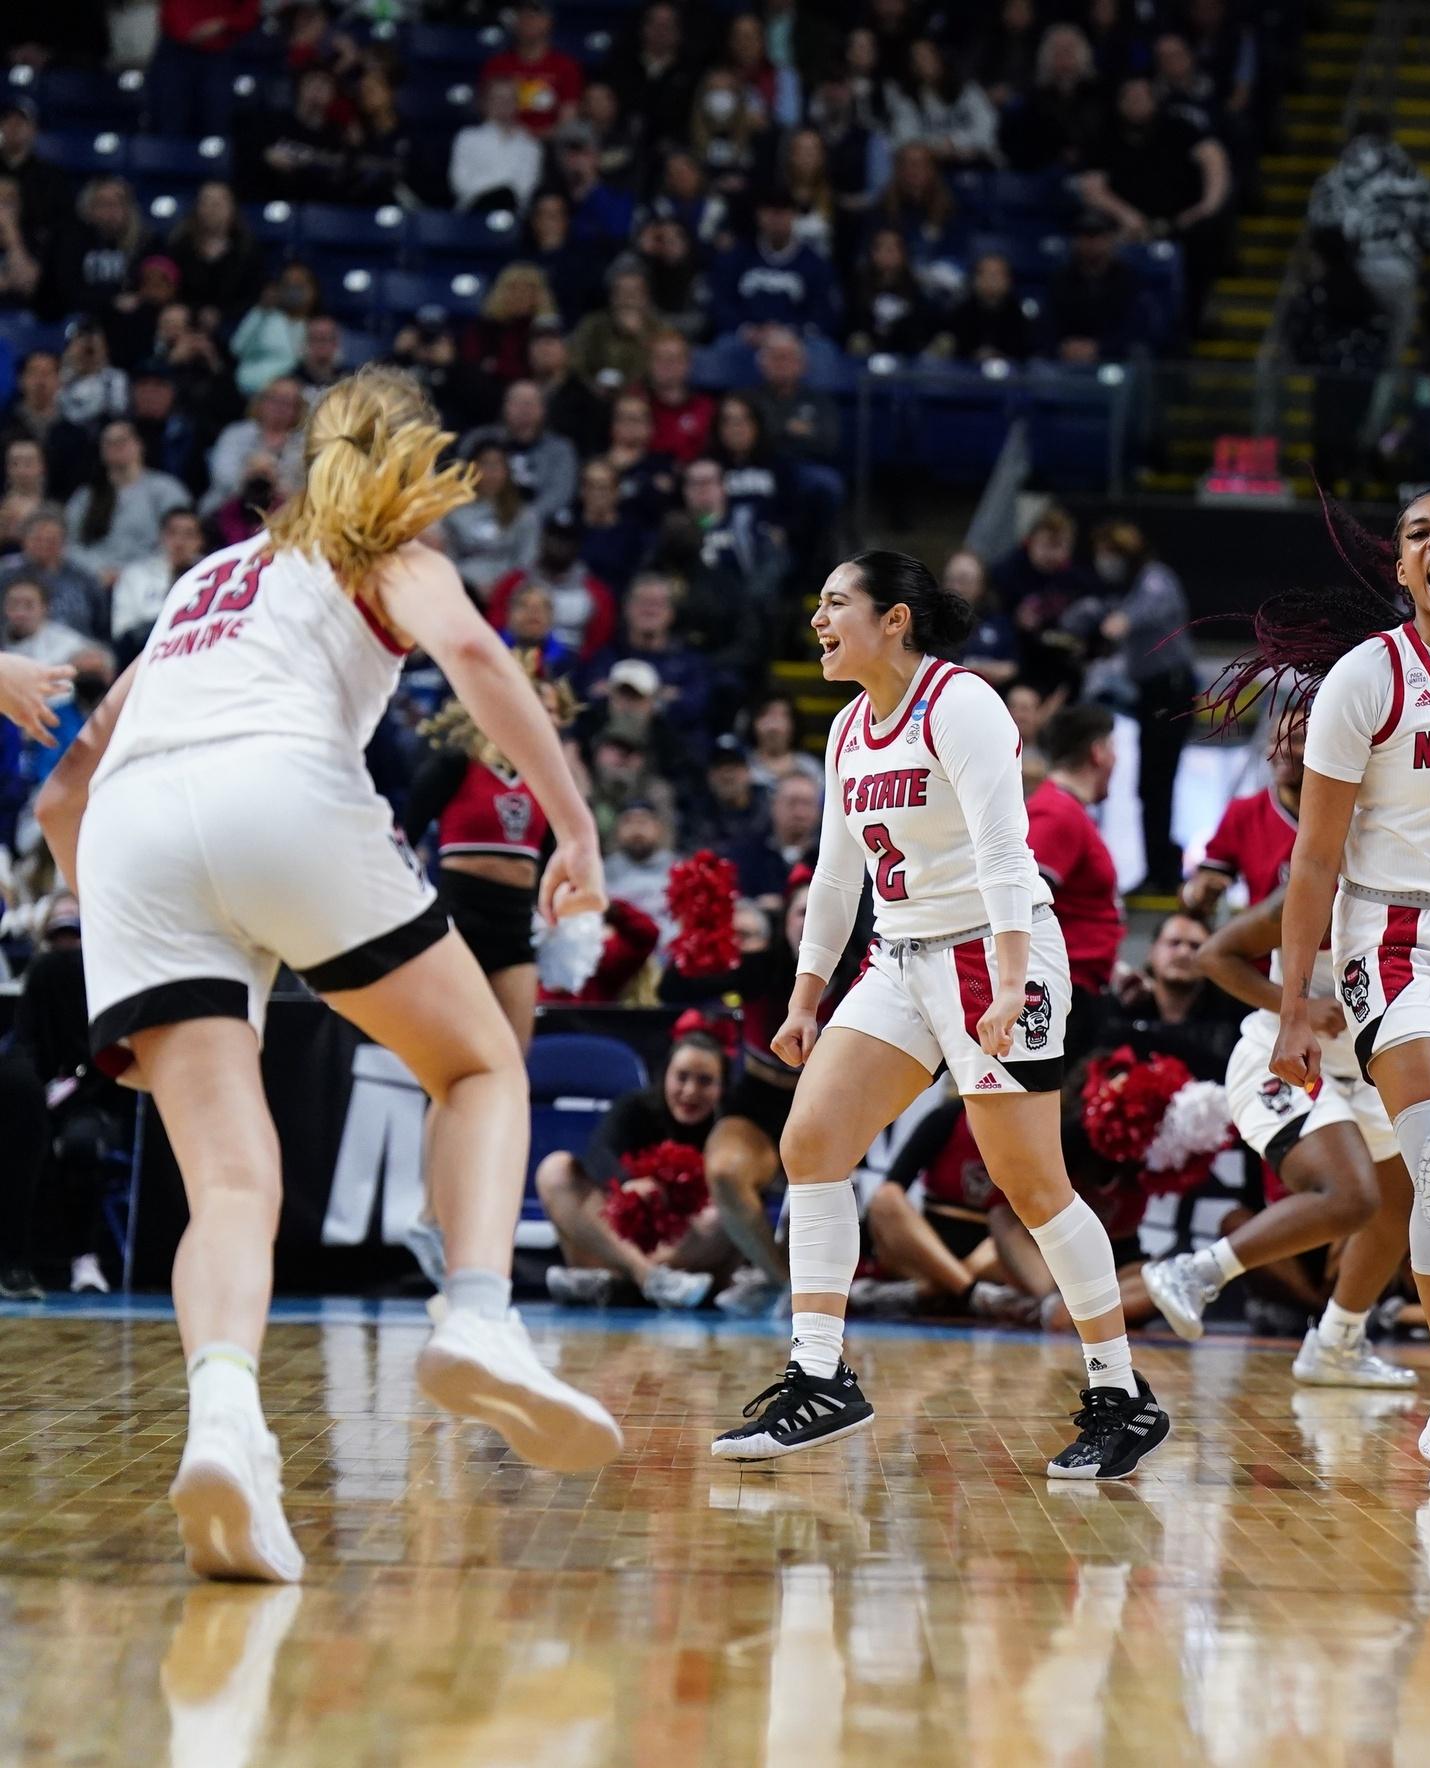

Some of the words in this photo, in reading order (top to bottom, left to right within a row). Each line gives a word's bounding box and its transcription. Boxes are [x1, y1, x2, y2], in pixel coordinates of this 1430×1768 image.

[169, 554, 275, 630] 33
[842, 777, 857, 816] C
[855, 768, 931, 813] STATE
[862, 822, 909, 902] 2
